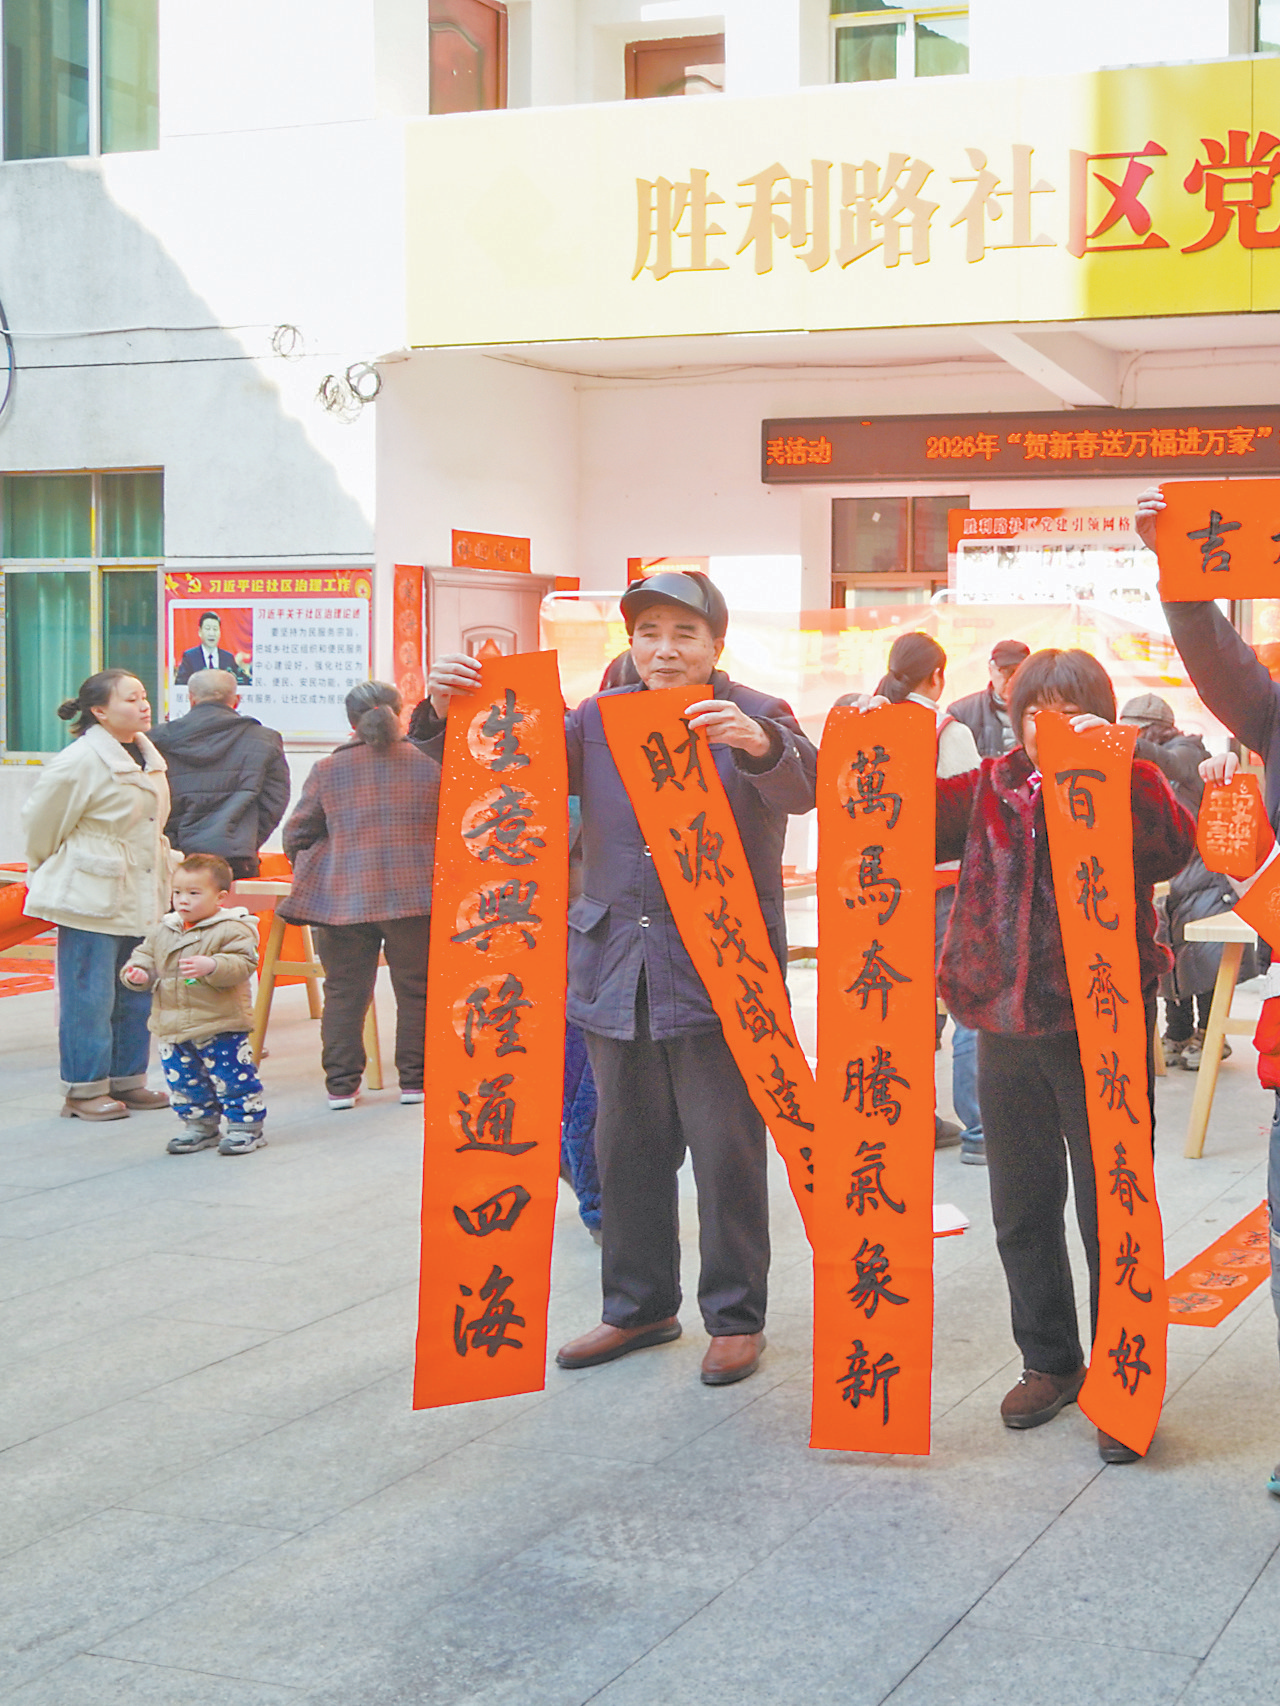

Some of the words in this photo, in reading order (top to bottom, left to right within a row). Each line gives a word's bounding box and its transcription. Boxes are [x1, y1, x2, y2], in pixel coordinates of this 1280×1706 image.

[451, 688, 546, 1358] 生意興隆通四海
[640, 717, 816, 1193] 財源茂盛達
[836, 745, 912, 1427] 萬馬奔騰氣象新
